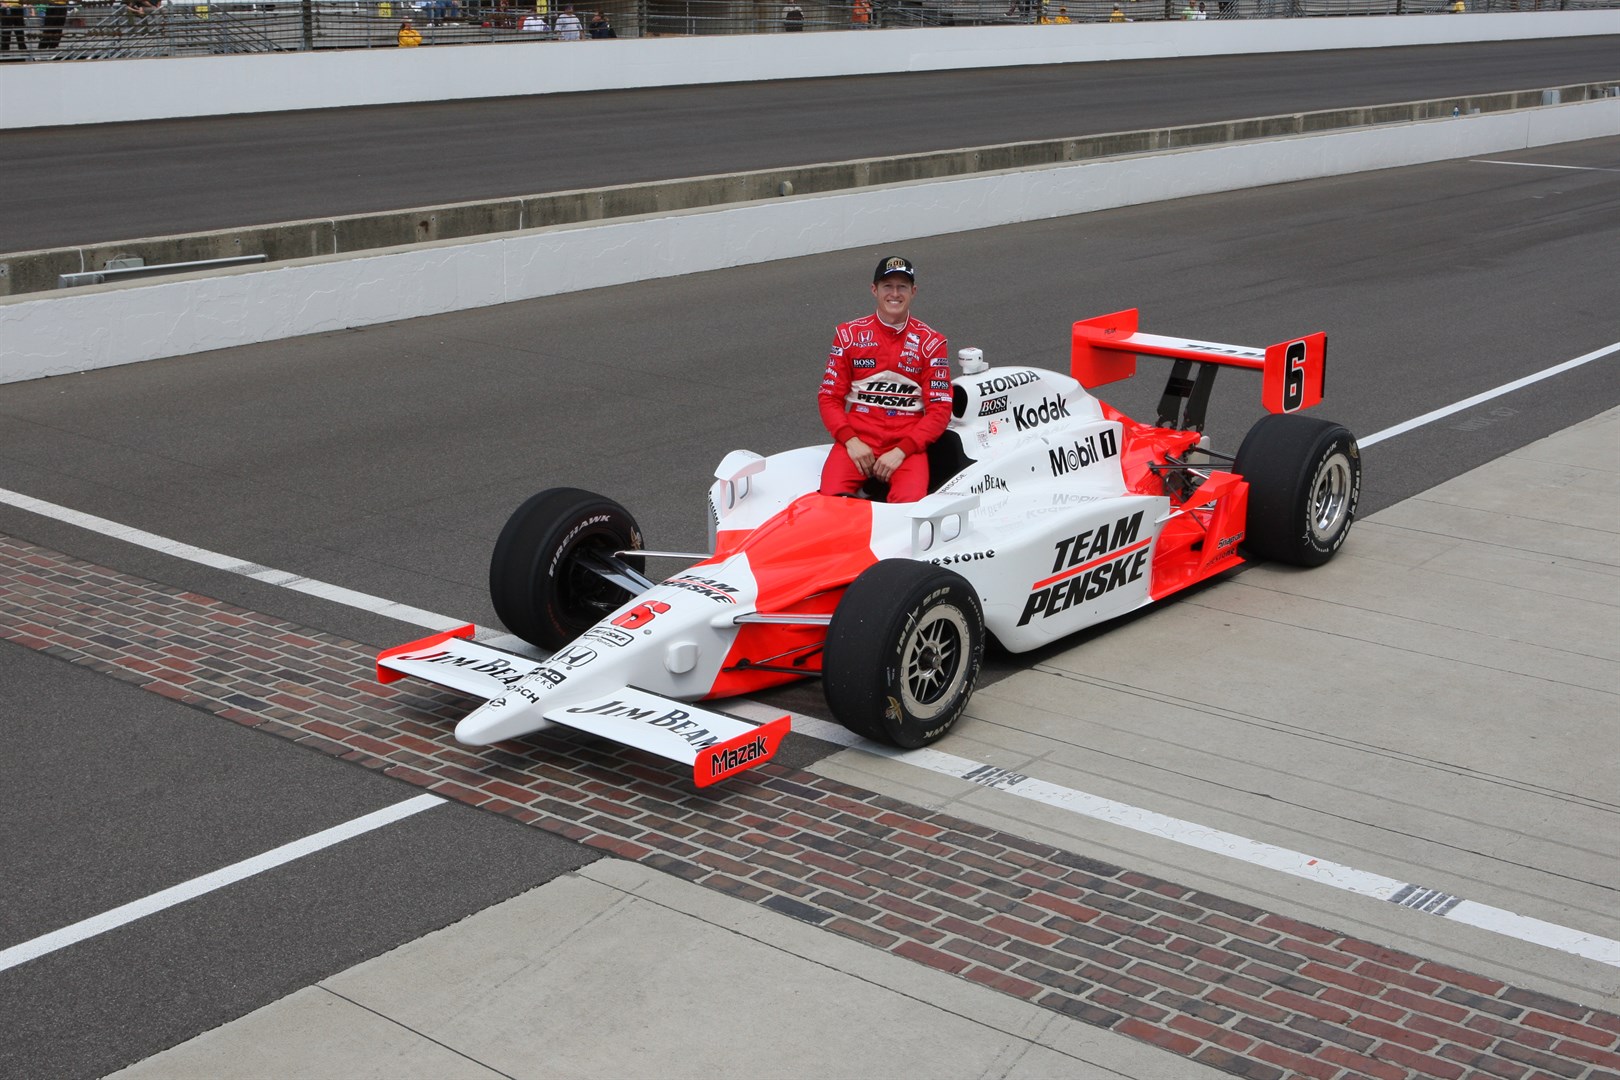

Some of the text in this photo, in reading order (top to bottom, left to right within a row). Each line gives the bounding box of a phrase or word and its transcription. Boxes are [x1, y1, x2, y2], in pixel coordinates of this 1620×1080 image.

[853, 359, 875, 367] BOSS
[867, 382, 918, 395] TEAM
[930, 380, 949, 388] BOSS
[976, 370, 1041, 397] HONDA
[1282, 340, 1307, 414] 6
[858, 393, 920, 408] PENSKE
[981, 396, 1007, 413] BOSS
[1013, 393, 1071, 432] Kodak
[1049, 431, 1115, 478] Mobil 1
[984, 474, 1011, 494] BEAM
[549, 514, 611, 578] FIREHAWK
[1052, 510, 1144, 574] TEAM
[679, 575, 740, 592] TEAM
[922, 587, 950, 607] 500
[1016, 546, 1149, 627] PENSKE
[610, 600, 671, 630] 6
[397, 651, 525, 685] JIM BEA
[566, 700, 654, 720] JIM
[711, 735, 769, 777] Mazak
